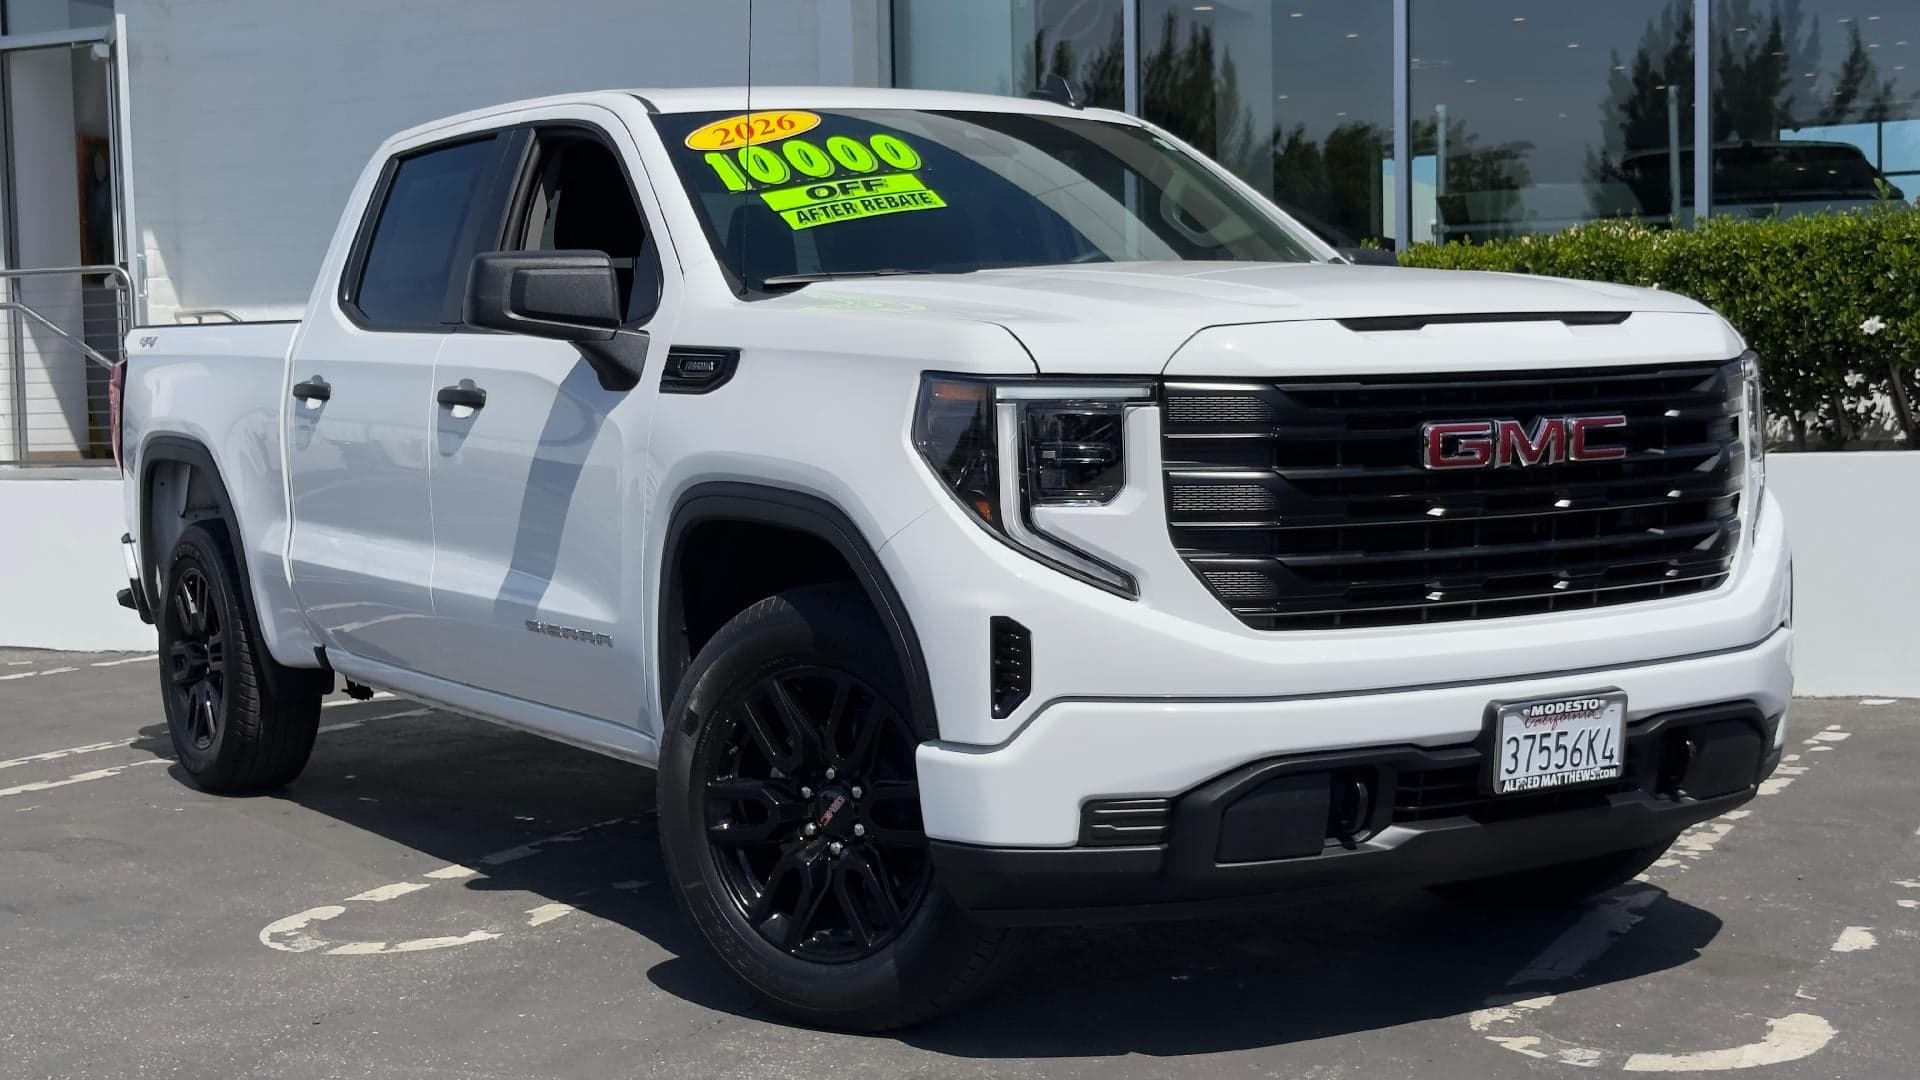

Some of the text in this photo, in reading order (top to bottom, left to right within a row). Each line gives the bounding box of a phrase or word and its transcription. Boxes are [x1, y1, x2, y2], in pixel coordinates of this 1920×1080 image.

[712, 114, 796, 146] 2026
[704, 134, 922, 192] 10000
[805, 178, 887, 200] OFF
[796, 193, 932, 224] AFTER REBATE
[1423, 415, 1626, 469] GMC
[1531, 699, 1599, 716] MODESTO
[1505, 728, 1614, 775] 37556K4
